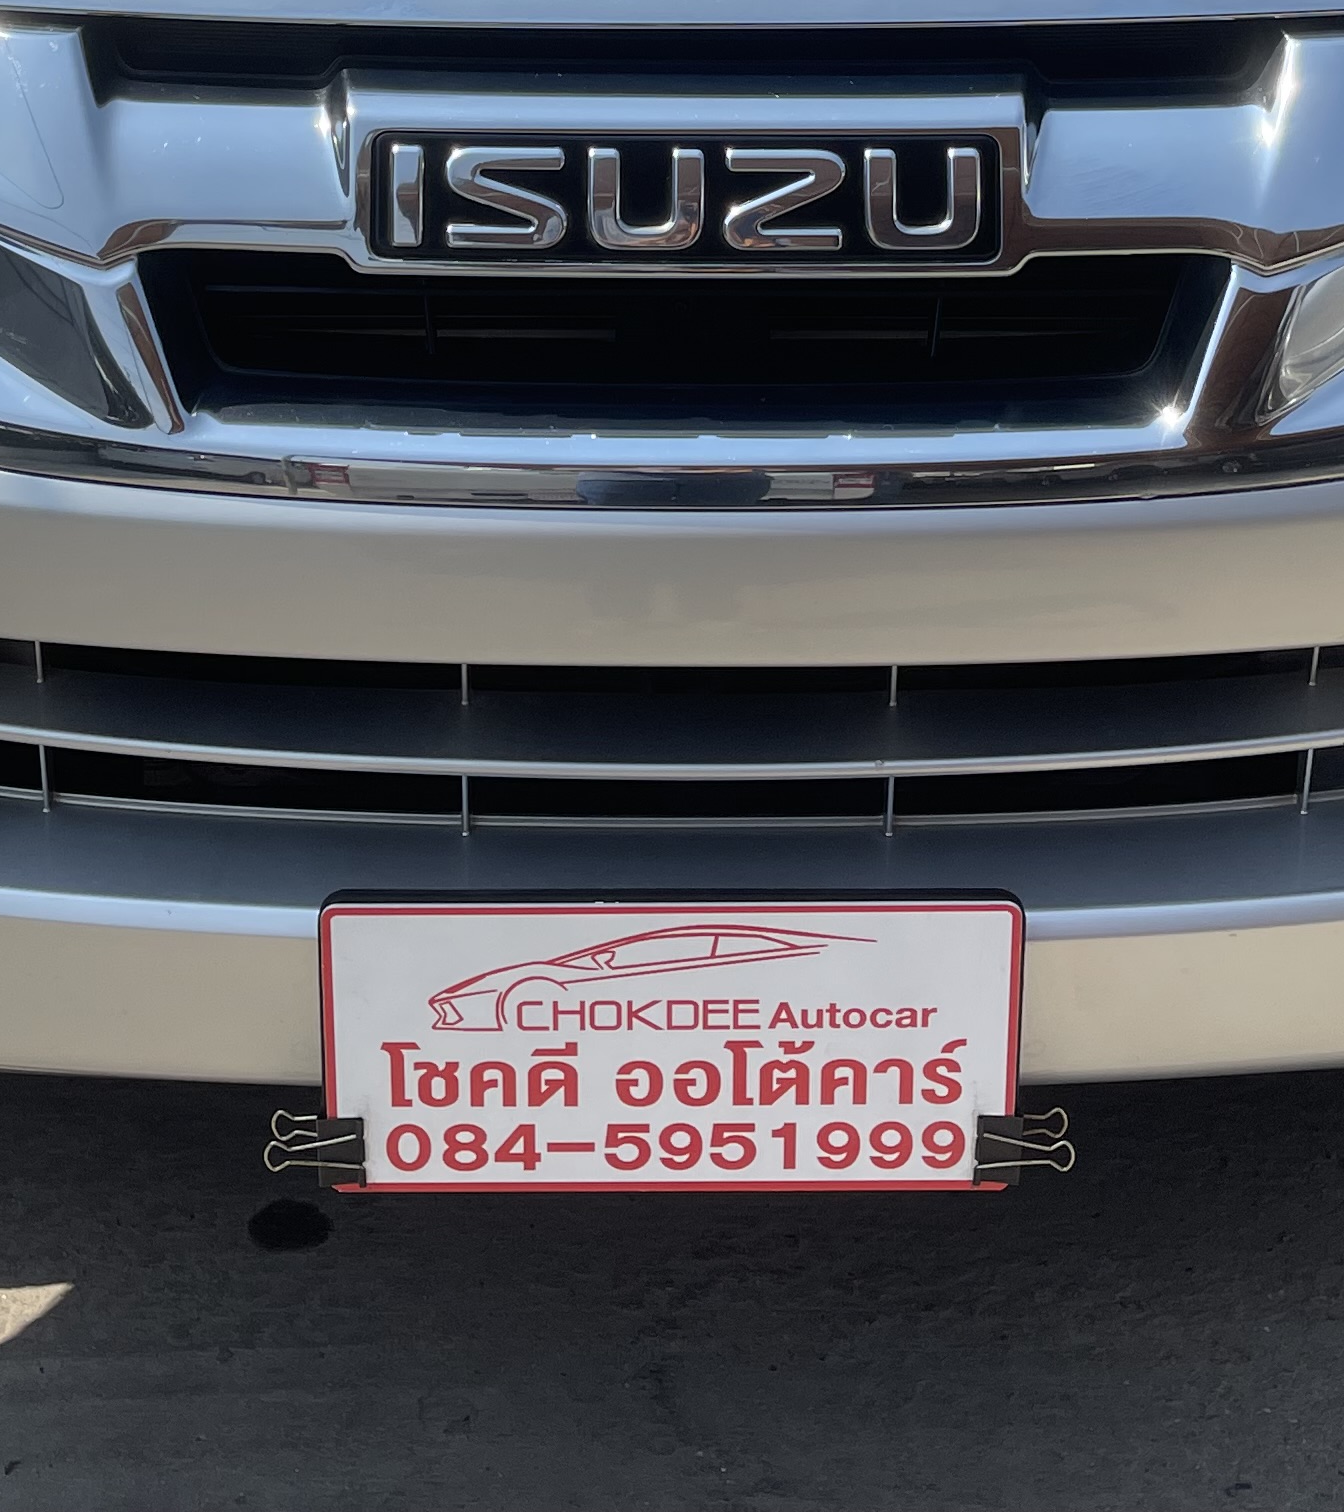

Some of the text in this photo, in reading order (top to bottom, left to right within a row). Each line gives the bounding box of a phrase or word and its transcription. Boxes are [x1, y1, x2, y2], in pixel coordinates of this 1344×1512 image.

[389, 144, 981, 251] ISUZU
[515, 998, 938, 1032] CHOKDEE Autocar
[380, 1038, 968, 1108] โชคดี ออโต้คาร์
[385, 1120, 967, 1172] 084-5951999
